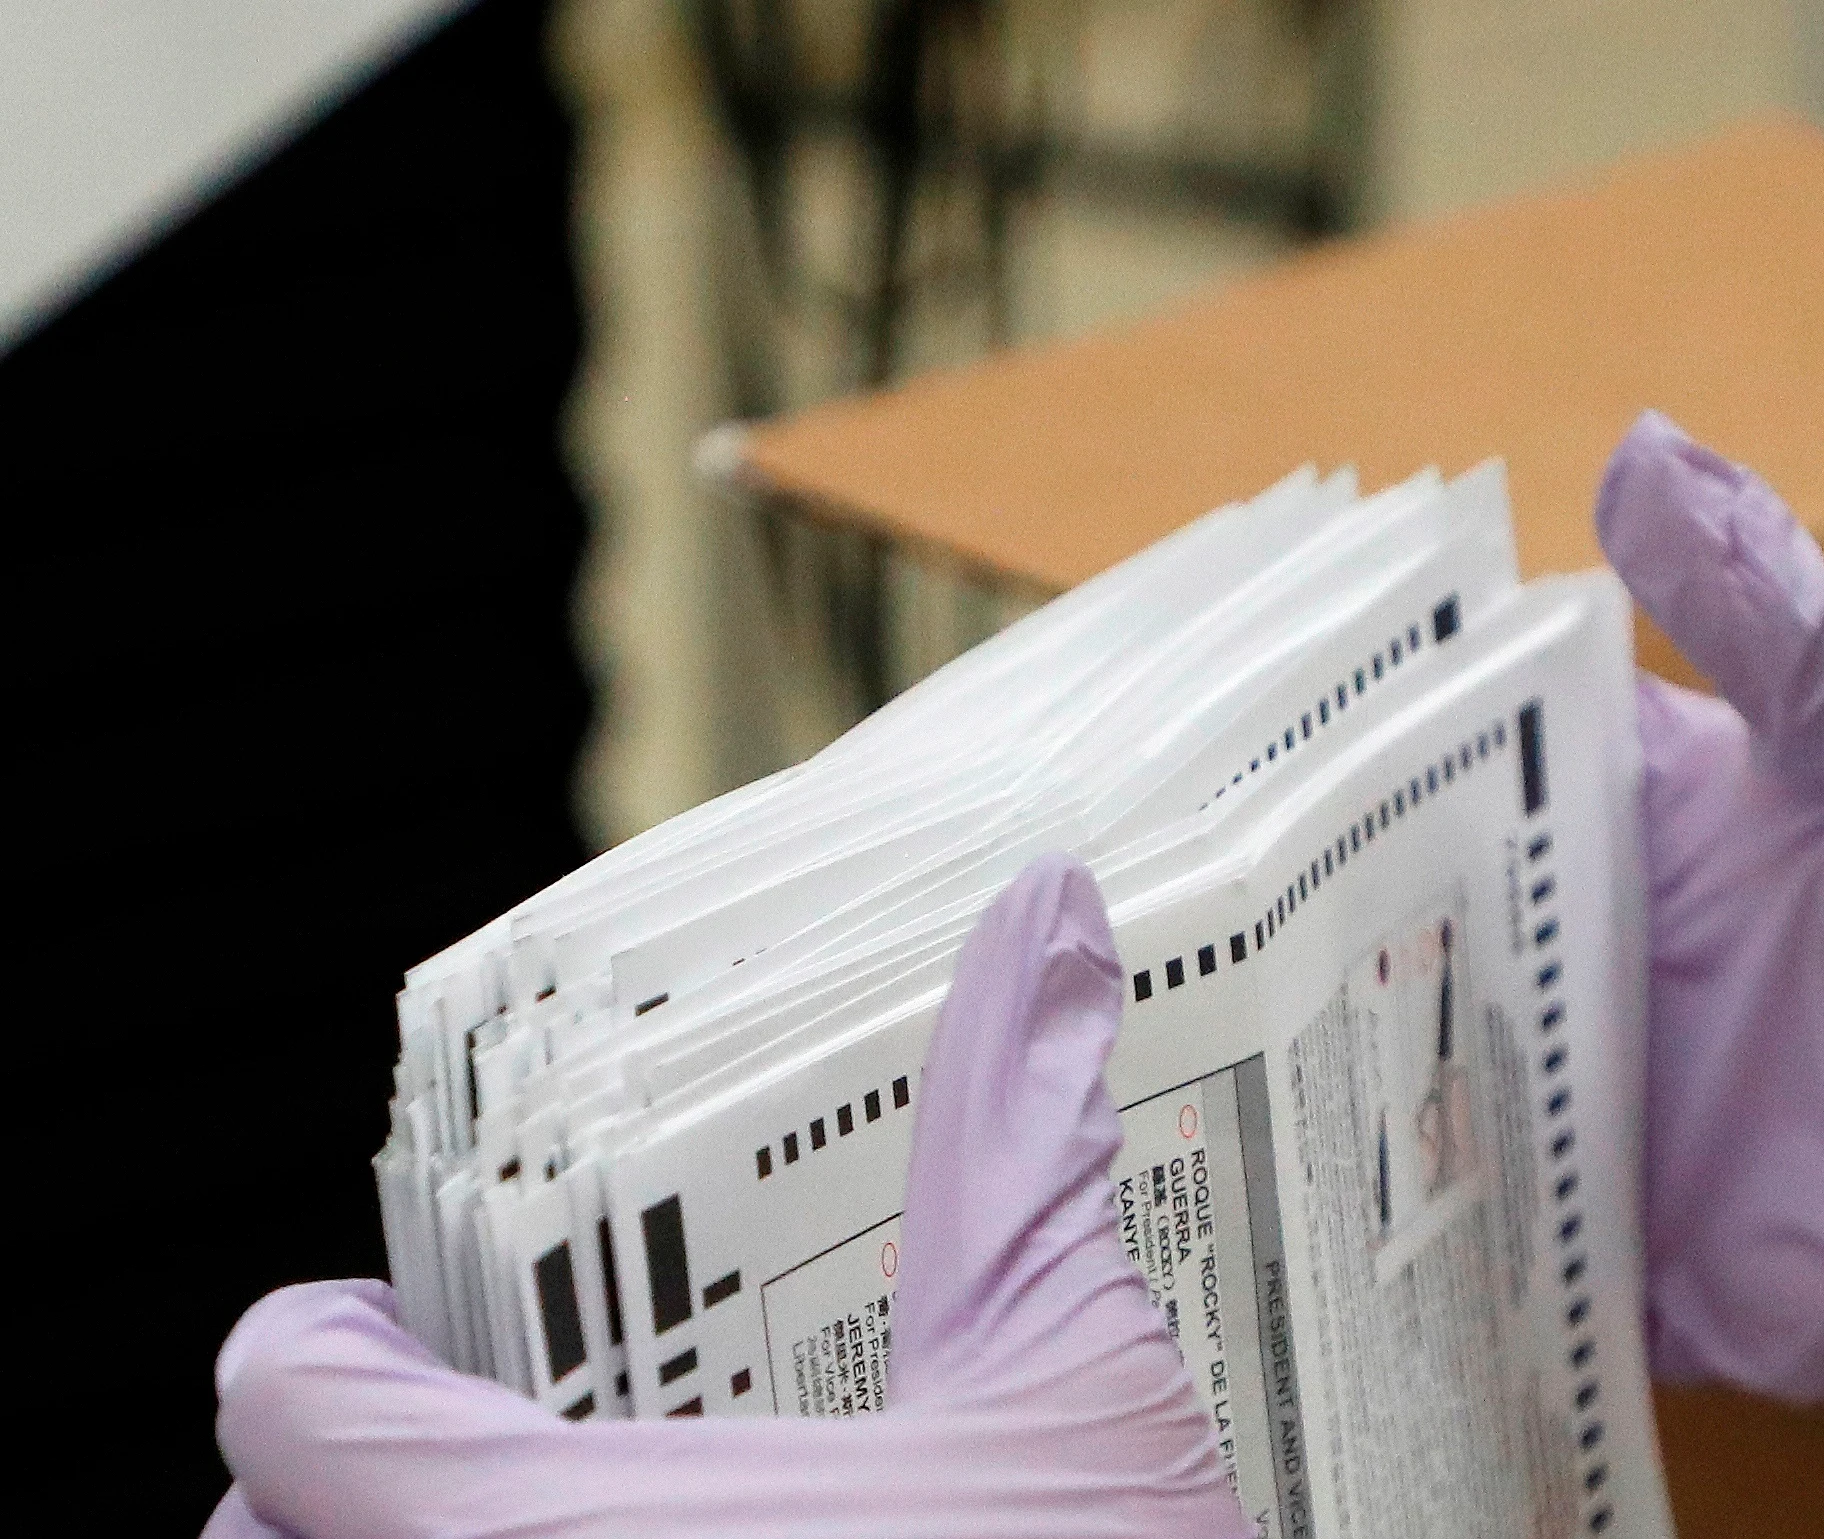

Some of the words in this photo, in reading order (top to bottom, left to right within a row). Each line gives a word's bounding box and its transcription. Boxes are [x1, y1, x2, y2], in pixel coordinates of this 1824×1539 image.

[1138, 1169, 1150, 1196] For
[1169, 1158, 1191, 1264] GUERRA
[1191, 1148, 1214, 1239] ROQUE
[1119, 1178, 1140, 1261] KANYE
[821, 1326, 832, 1356] For
[865, 1302, 876, 1333] For
[847, 1313, 871, 1411] JEREMY
[1210, 1360, 1227, 1395] DE
[1265, 1260, 1294, 1408] PRESIDENT
[1280, 1420, 1301, 1475] AND
[1215, 1400, 1231, 1432] LA
